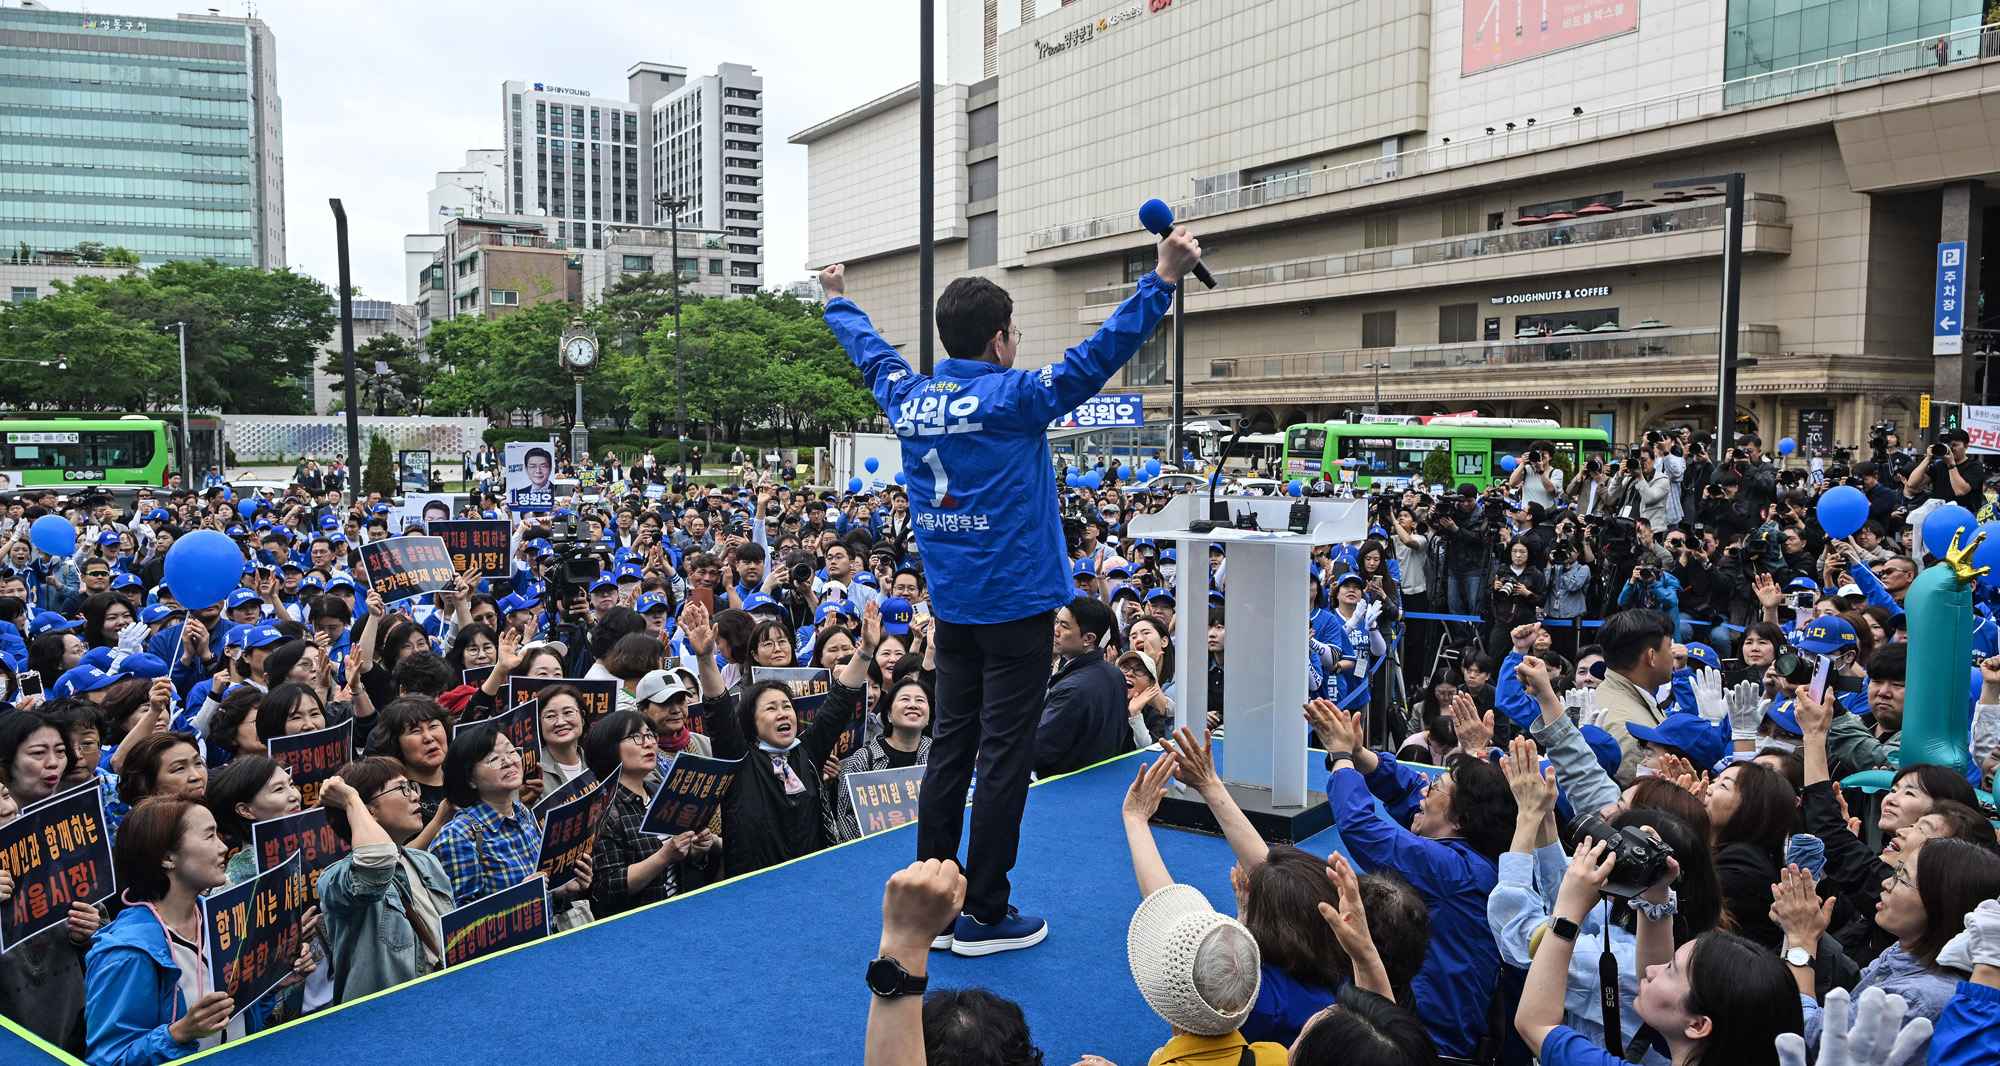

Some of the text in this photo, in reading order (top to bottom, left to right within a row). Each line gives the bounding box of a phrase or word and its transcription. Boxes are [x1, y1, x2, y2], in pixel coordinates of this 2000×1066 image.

[100, 19, 147, 32] 성동구청
[546, 85, 591, 97] SHINYOUNG
[1945, 251, 1954, 263] P
[1506, 290, 1562, 304] DOUGHNUTS
[1565, 289, 1572, 299] &
[1574, 286, 1609, 298] COFFEE
[1943, 271, 1956, 311] 주차장
[894, 395, 983, 437] 정원오
[1075, 403, 1136, 427] 정원오
[921, 448, 958, 508] 1
[509, 488, 553, 506] 1 정원오
[916, 512, 990, 532] 서울시장후보
[433, 530, 507, 548] 립지원 확대하는
[369, 545, 444, 572] 최중증 발달장애
[453, 553, 504, 571] 울시장!
[375, 567, 454, 593] 국가책임제 실현!
[642, 595, 661, 604] 1-나
[894, 612, 909, 622] 1-나
[1777, 700, 1793, 713] 1
[668, 769, 717, 798] 자립지원
[856, 782, 902, 807] 자립지원
[44, 812, 98, 860] 함께하는
[13, 860, 98, 926] 서울시장!
[216, 901, 247, 951] 함께
[256, 889, 277, 928] 사는
[447, 897, 542, 965] 발달장애인의 내일을
[222, 941, 269, 997] 행복한
[1605, 986, 1615, 1008] EOS
